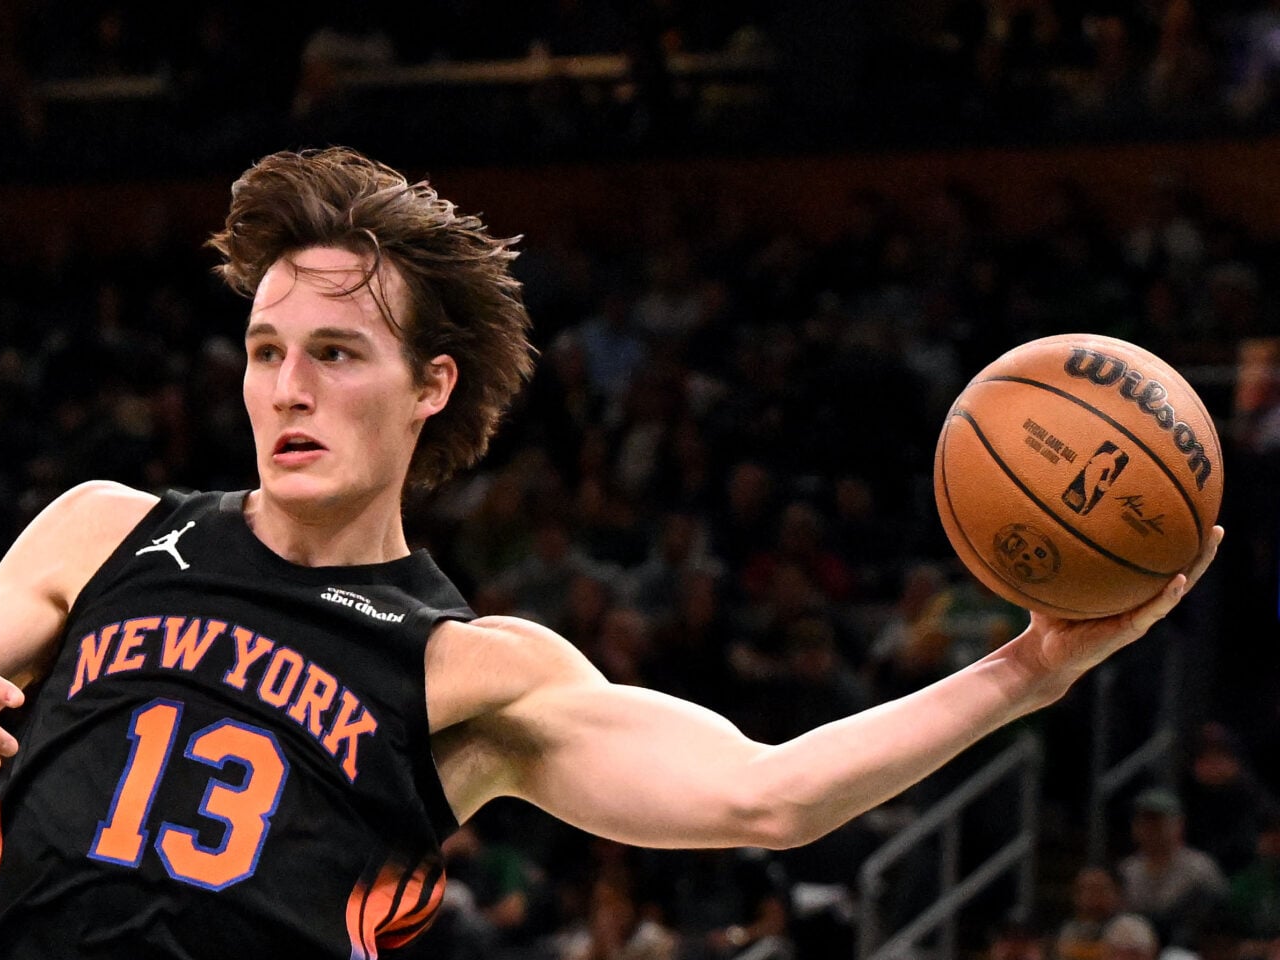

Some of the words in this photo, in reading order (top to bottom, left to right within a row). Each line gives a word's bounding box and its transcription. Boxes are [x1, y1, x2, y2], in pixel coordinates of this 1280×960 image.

[1064, 347, 1211, 490] Wilson
[320, 592, 354, 607] abu
[354, 602, 405, 623] dhabi
[68, 615, 227, 700] NEW
[223, 624, 378, 784] YORK
[87, 697, 290, 891] 13
